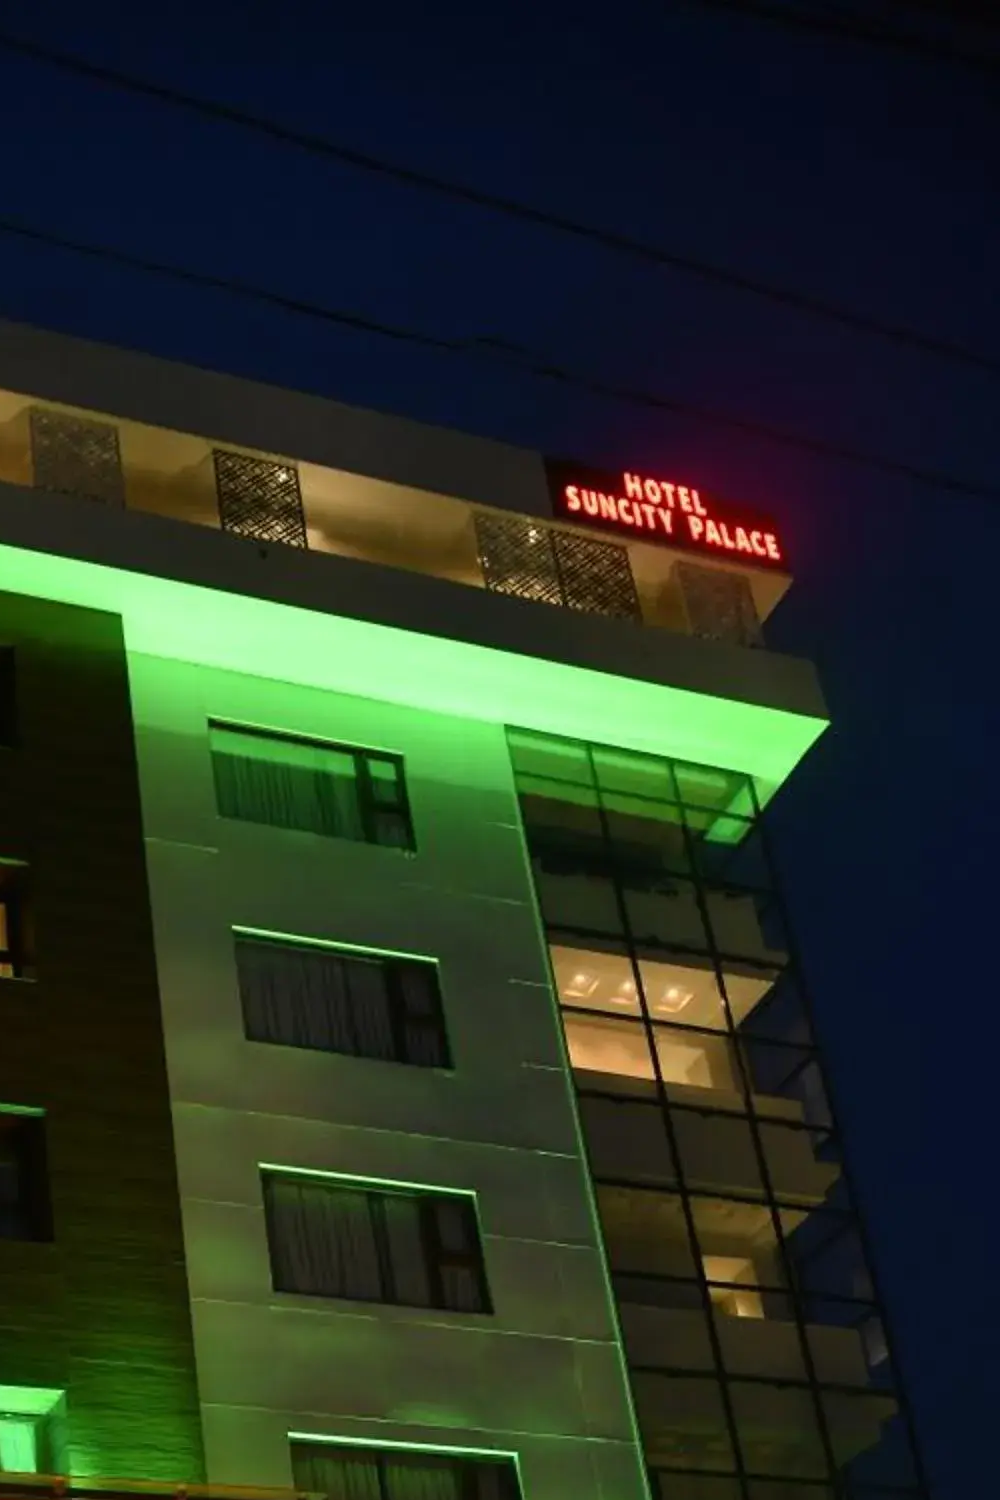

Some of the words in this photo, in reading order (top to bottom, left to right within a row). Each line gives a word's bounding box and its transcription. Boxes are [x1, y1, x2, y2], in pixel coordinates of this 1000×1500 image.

[565, 485, 672, 534] SUNCITY
[688, 516, 780, 560] PALACE
[623, 472, 706, 515] HOTEL
